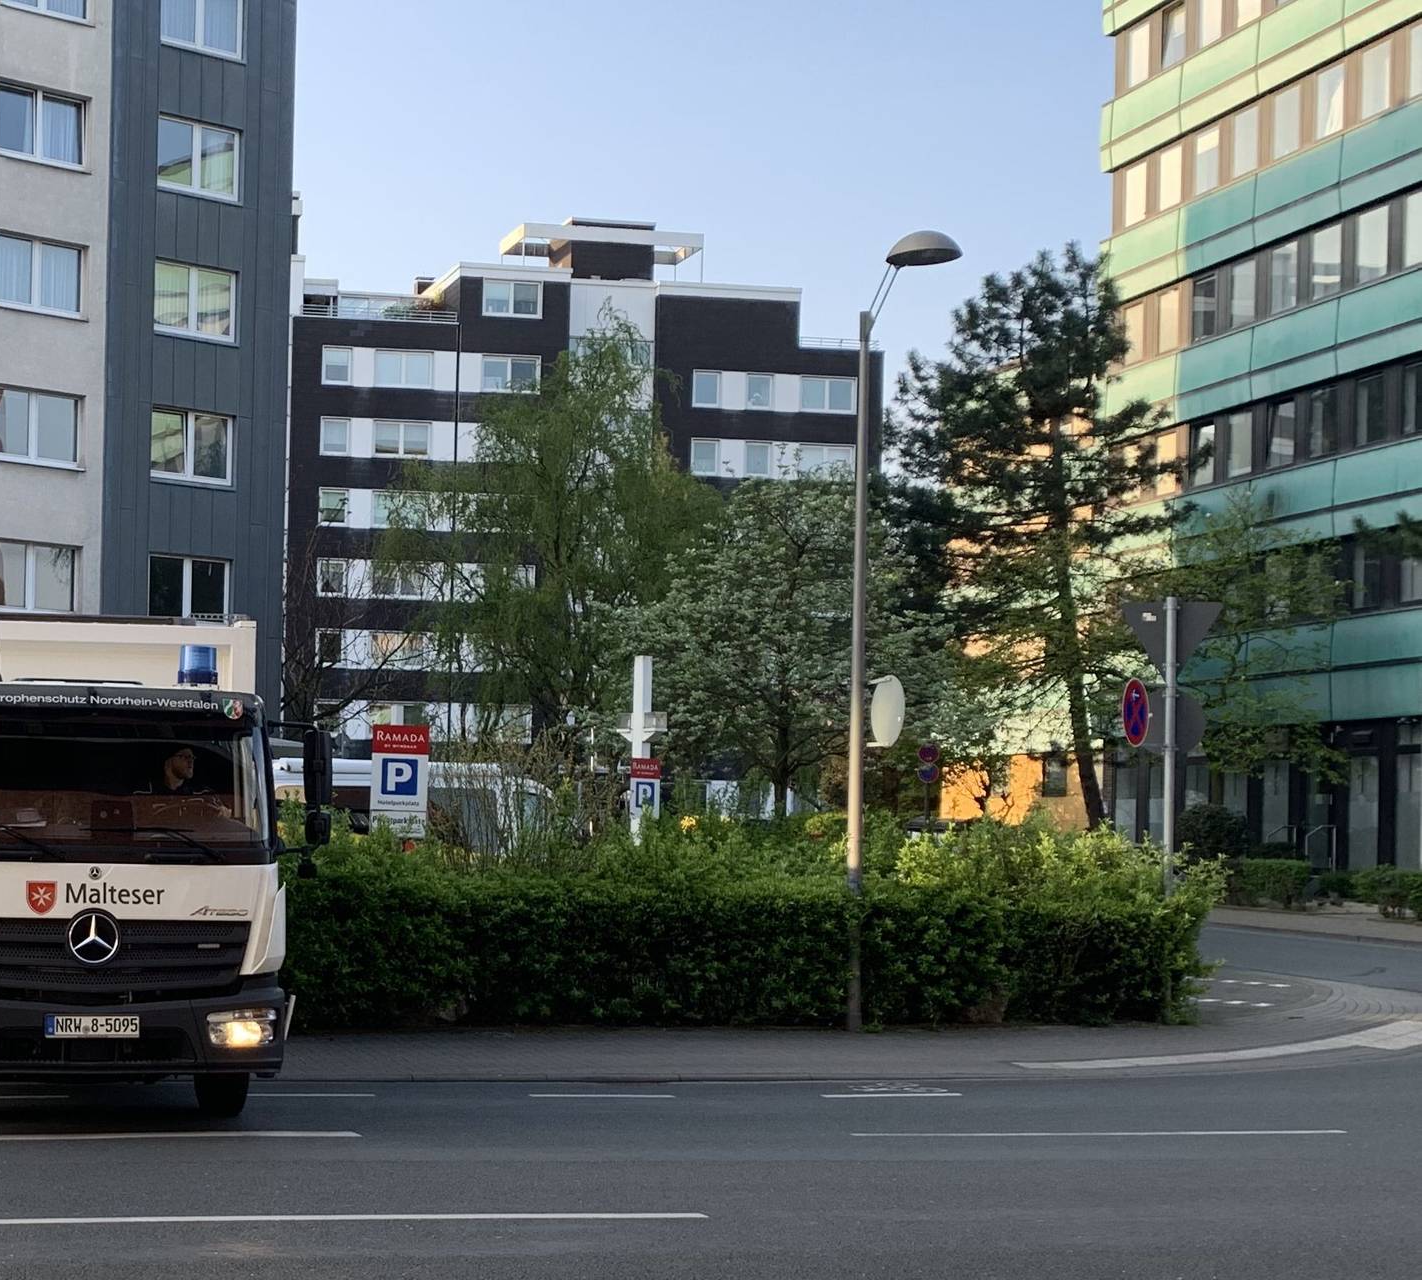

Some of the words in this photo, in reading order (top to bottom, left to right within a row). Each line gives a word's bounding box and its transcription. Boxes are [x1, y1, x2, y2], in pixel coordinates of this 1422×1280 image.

[90, 695, 219, 711] Nordrhein-Westfalen
[376, 730, 426, 743] RAMADA
[386, 762, 413, 792] P
[65, 882, 165, 905] Malteser
[55, 1018, 82, 1033] NRW
[91, 1018, 138, 1033] 8-5095
